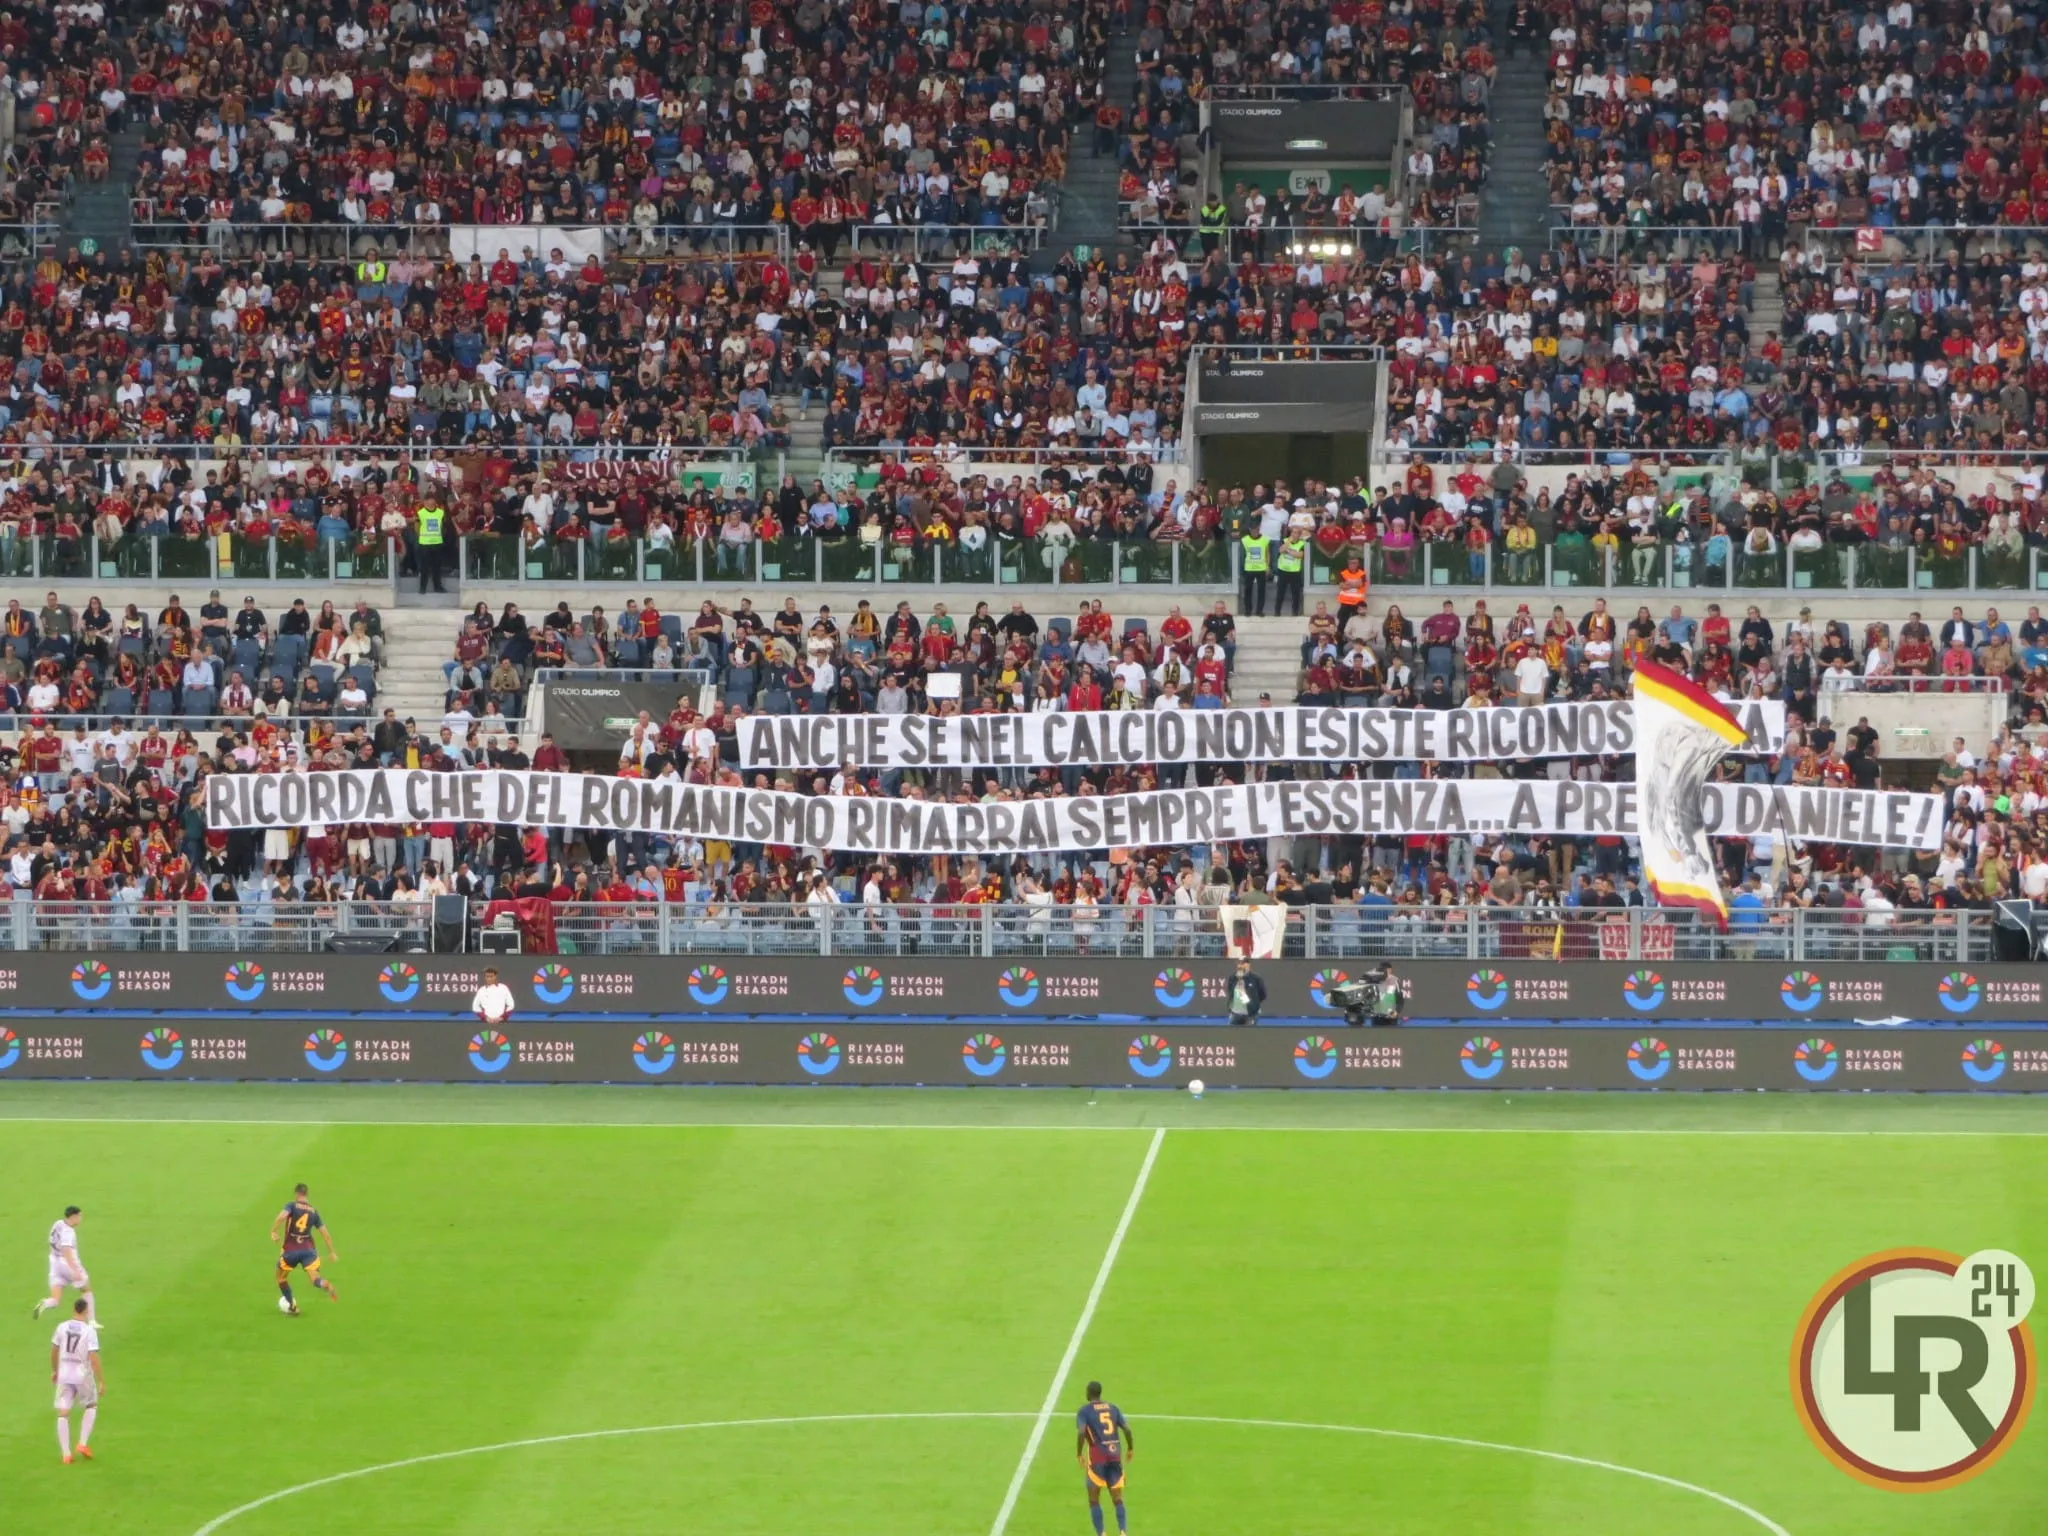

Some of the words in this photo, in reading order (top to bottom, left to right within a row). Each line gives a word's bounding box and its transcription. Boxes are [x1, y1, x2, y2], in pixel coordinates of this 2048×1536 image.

[1219, 108, 1245, 116] STADIO
[1246, 108, 1282, 116] OLIMPICO
[1230, 369, 1264, 377] OLIMPICO
[1225, 412, 1260, 420] OLIMPICO
[551, 688, 580, 696] STADIO
[581, 688, 621, 697] OLIMPICO
[749, 716, 889, 766] ANCHE
[899, 715, 949, 764] SE
[960, 715, 1033, 764] NEL
[1043, 710, 1186, 763] CALCIO
[1195, 710, 1284, 759] NON
[1296, 709, 1436, 758] ESISTE
[209, 771, 395, 826] RICORDA
[406, 770, 484, 822] CHE
[497, 773, 567, 824] DEL
[580, 777, 834, 847] ROMANISMO
[847, 797, 1060, 851] RIMARRAI
[1067, 788, 1237, 847] SEMPRE
[1735, 785, 1935, 848] DANIELE!
[1600, 923, 1676, 951] GRPPO
[118, 970, 171, 980] RIYADH
[272, 971, 325, 982] RIYADH
[426, 972, 479, 983] RIYADH
[580, 973, 633, 984] RIYADH
[735, 975, 788, 985] RIYADH
[118, 980, 171, 991] SEASON
[272, 981, 325, 992] SEASON
[890, 975, 944, 987] RIYADH
[1046, 976, 1099, 987] RIYADH
[1513, 979, 1569, 990] RIYADH
[1671, 980, 1726, 991] RIYADH
[1828, 981, 1883, 992] RIYADH
[426, 982, 479, 993] SEASON
[580, 984, 633, 994] SEASON
[735, 985, 788, 996] SEASON
[890, 986, 944, 997] SEASON
[1046, 987, 1099, 998] SEASON
[1986, 982, 2041, 993] RIYADH
[1513, 990, 1569, 1001] SEASON
[1671, 991, 1726, 1002] SEASON
[1828, 991, 1883, 1003] SEASON
[1986, 992, 2041, 1003] SEASON
[27, 1037, 83, 1048] RIYADH
[191, 1038, 247, 1049] RIYADH
[354, 1039, 411, 1051] RIYADH
[518, 1041, 575, 1052] RIYADH
[682, 1042, 739, 1053] RIYADH
[27, 1048, 83, 1059] SEASON
[847, 1043, 904, 1054] RIYADH
[1013, 1044, 1070, 1055] RIYADH
[1178, 1045, 1236, 1057] RIYADH
[1344, 1046, 1402, 1058] RIYADH
[1511, 1047, 1569, 1058] RIYADH
[1677, 1048, 1736, 1059] RIYADH
[191, 1049, 247, 1060] SEASON
[354, 1051, 411, 1062] SEASON
[518, 1052, 575, 1063] SEASON
[682, 1053, 739, 1064] SEASON
[847, 1054, 904, 1065] SEASON
[1844, 1049, 1904, 1060] RIYADH
[2012, 1050, 2048, 1061] RIYA
[1013, 1055, 1070, 1067] SEASON
[1178, 1056, 1236, 1068] SEASON
[1344, 1057, 1402, 1069] SEASON
[1511, 1058, 1569, 1070] SEASON
[1677, 1059, 1736, 1071] SEASON
[1844, 1060, 1904, 1072] SEASON
[2012, 1061, 2048, 1072] SEAS
[296, 1213, 309, 1233] 4
[66, 1331, 81, 1354] 17
[1099, 1411, 1115, 1435] 5
